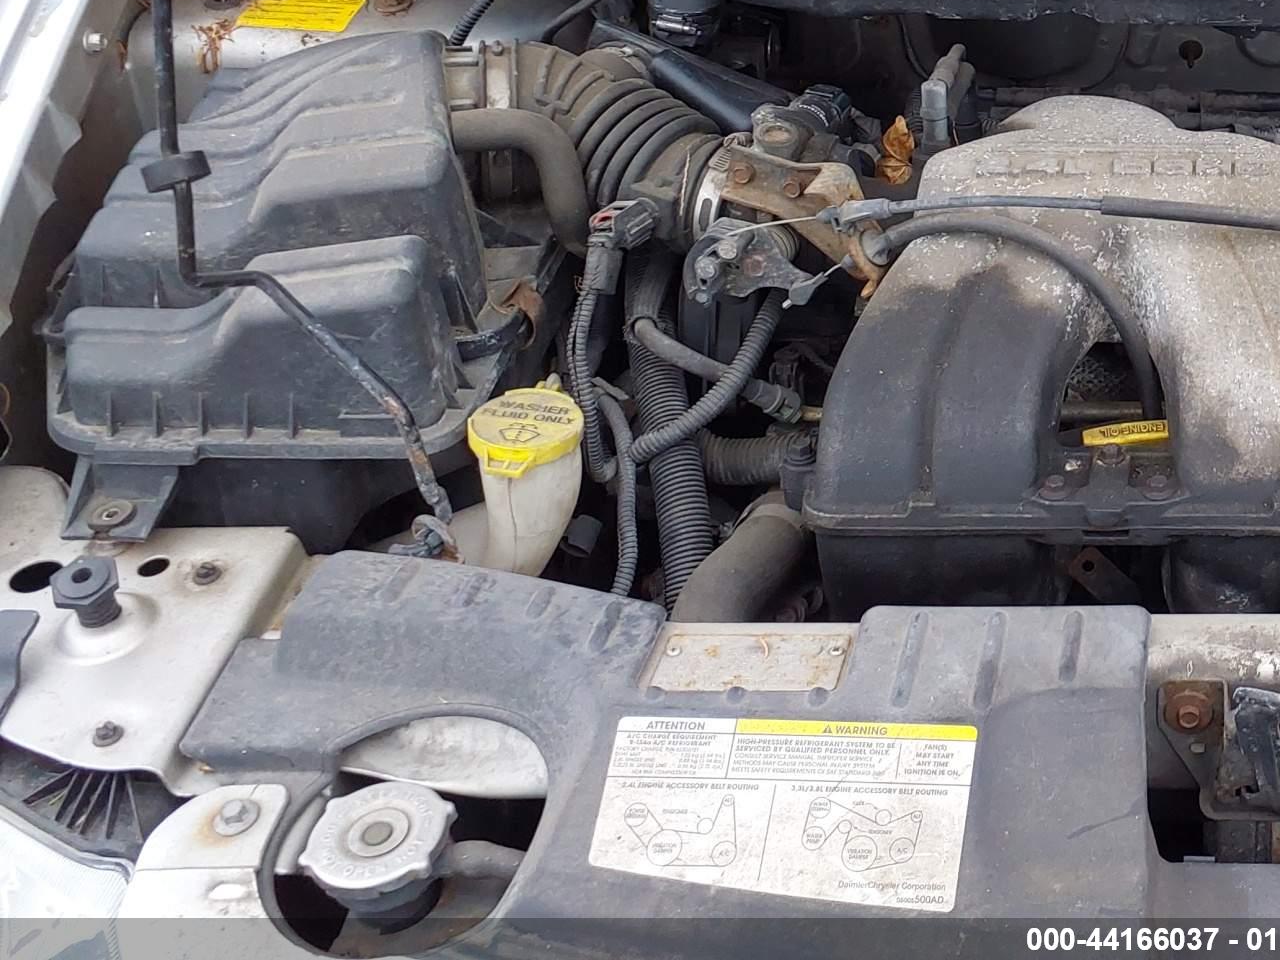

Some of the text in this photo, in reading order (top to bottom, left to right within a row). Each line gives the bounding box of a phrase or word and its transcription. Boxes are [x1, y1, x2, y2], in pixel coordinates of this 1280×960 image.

[500, 400, 569, 415] WASHER
[481, 408, 577, 424] FLUID ONLY
[1100, 422, 1164, 438] ENGINE OIL
[646, 721, 705, 730] ATTENTION
[835, 726, 888, 735] WARNING
[737, 738, 794, 746] HIGH-PRESSURE
[795, 739, 844, 747] REFRIGERANT
[904, 768, 938, 776] IGNITION
[854, 787, 896, 795] ACCESSORY
[916, 788, 948, 796] ROUTING
[838, 880, 946, 892] DaimlerChrysler Corporation
